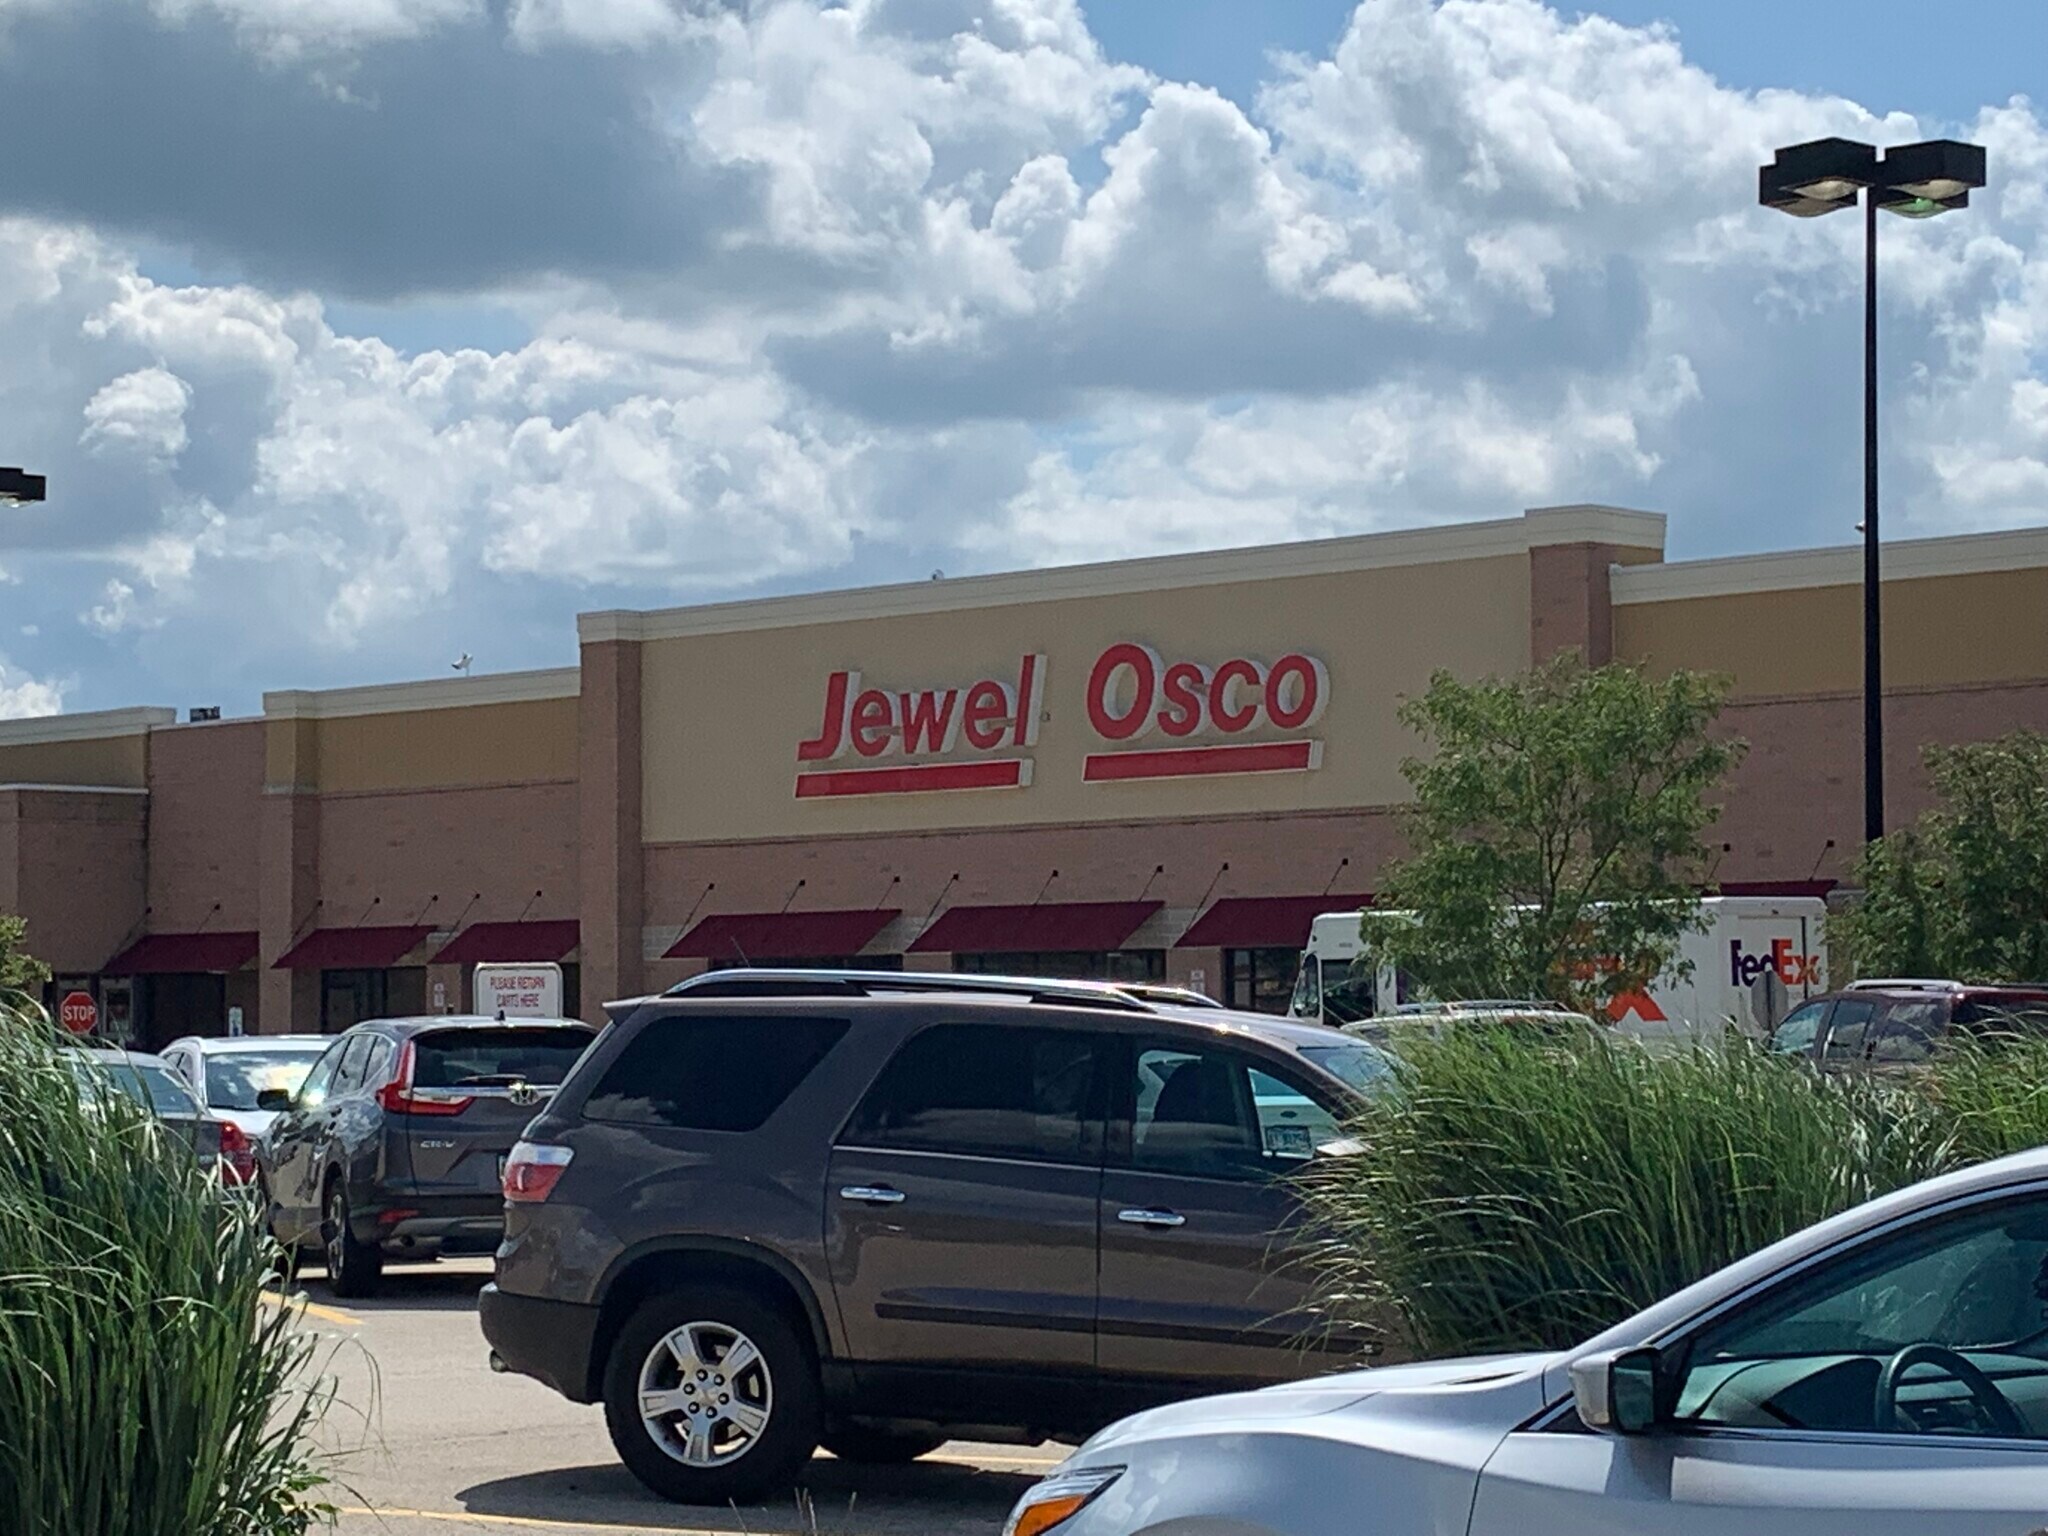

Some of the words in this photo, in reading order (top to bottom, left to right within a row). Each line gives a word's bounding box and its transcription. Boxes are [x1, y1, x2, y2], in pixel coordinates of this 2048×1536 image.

[797, 653, 1047, 761] Jewel
[1086, 642, 1330, 742] Osco
[1730, 938, 1820, 988] FedEx
[490, 976, 517, 990] PLEASE
[518, 976, 545, 990] RETURN
[496, 993, 519, 1008] CARTS
[520, 993, 540, 1008] HERE
[63, 1005, 96, 1021] STOP
